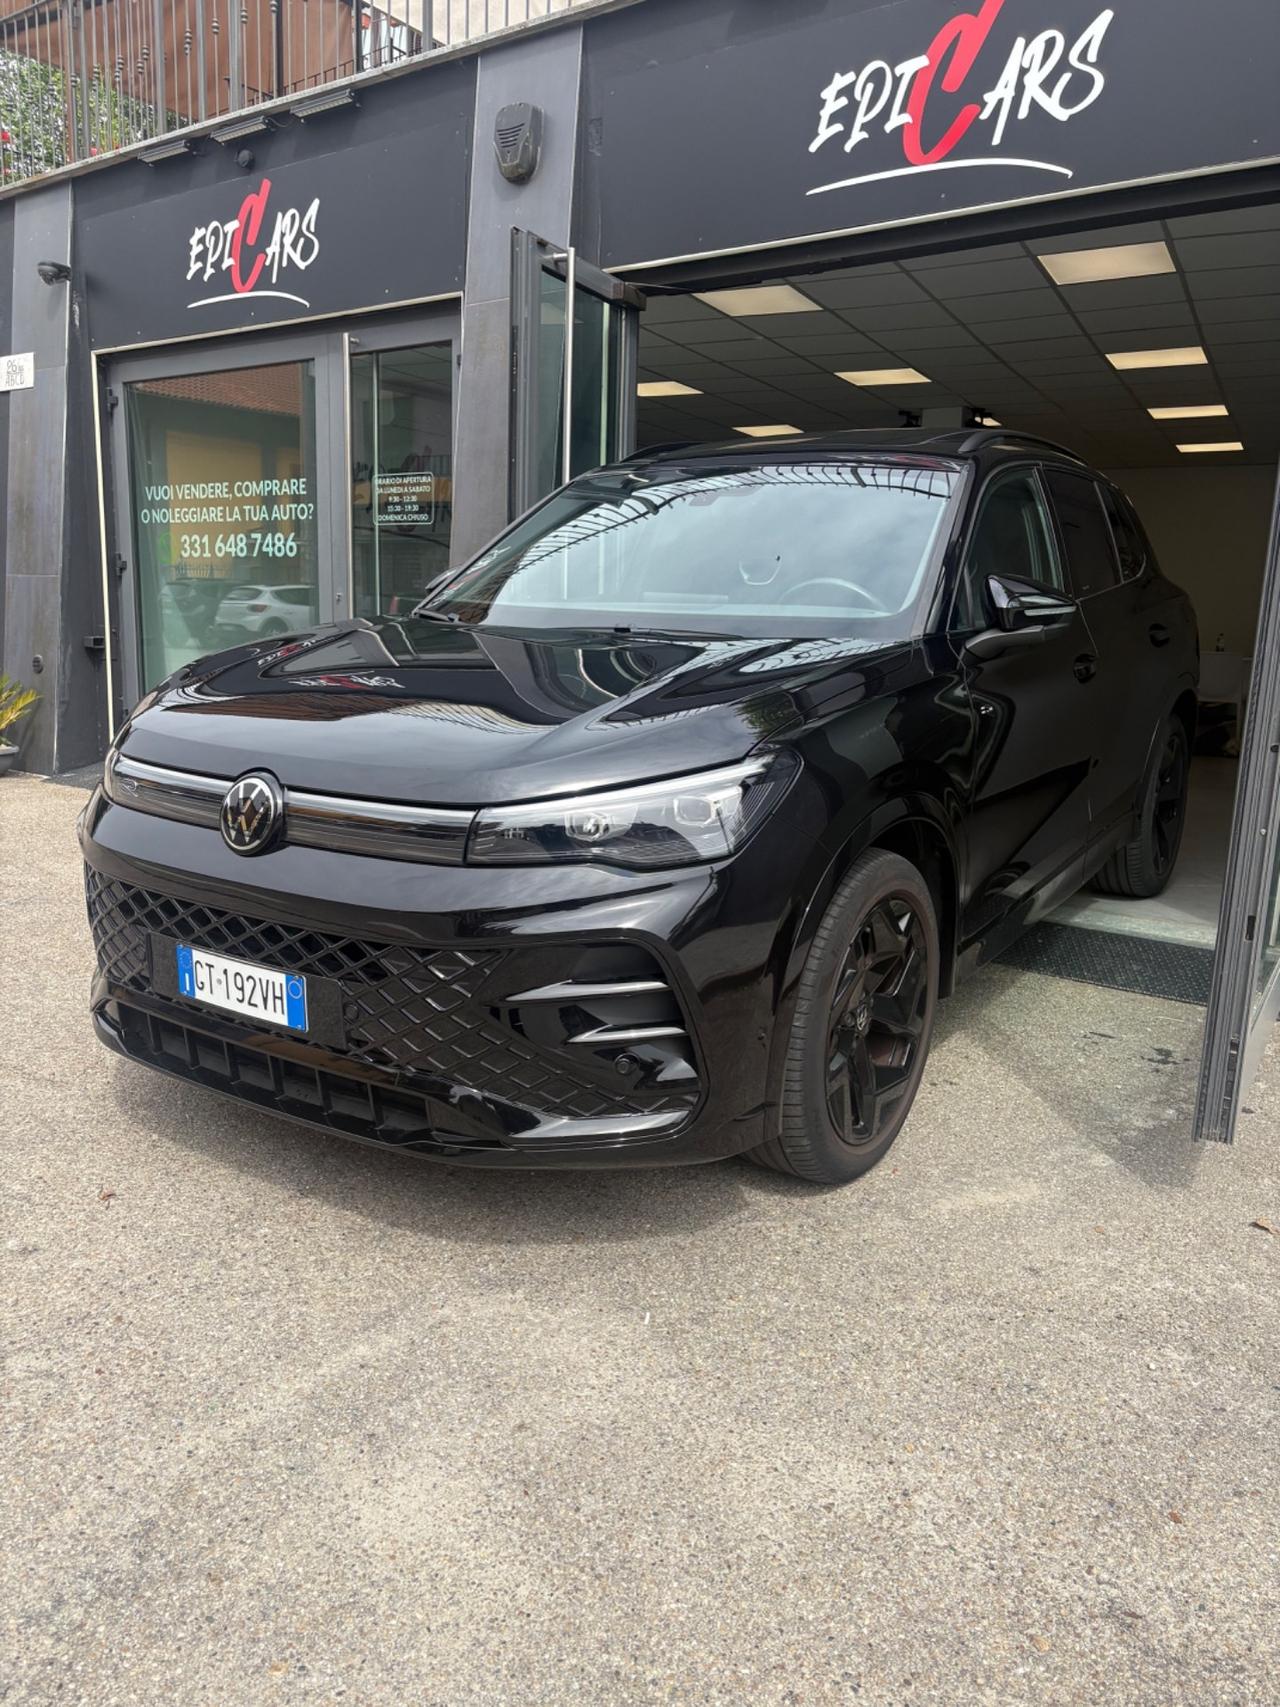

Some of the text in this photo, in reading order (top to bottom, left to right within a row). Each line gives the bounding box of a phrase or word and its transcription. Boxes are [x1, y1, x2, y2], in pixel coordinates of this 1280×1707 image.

[145, 477, 307, 501] VUOI VENDERE, COMPRARE
[141, 503, 314, 524] O NOLEGGIARE LA TUA AUTO?
[180, 531, 298, 558] 331 648 7486
